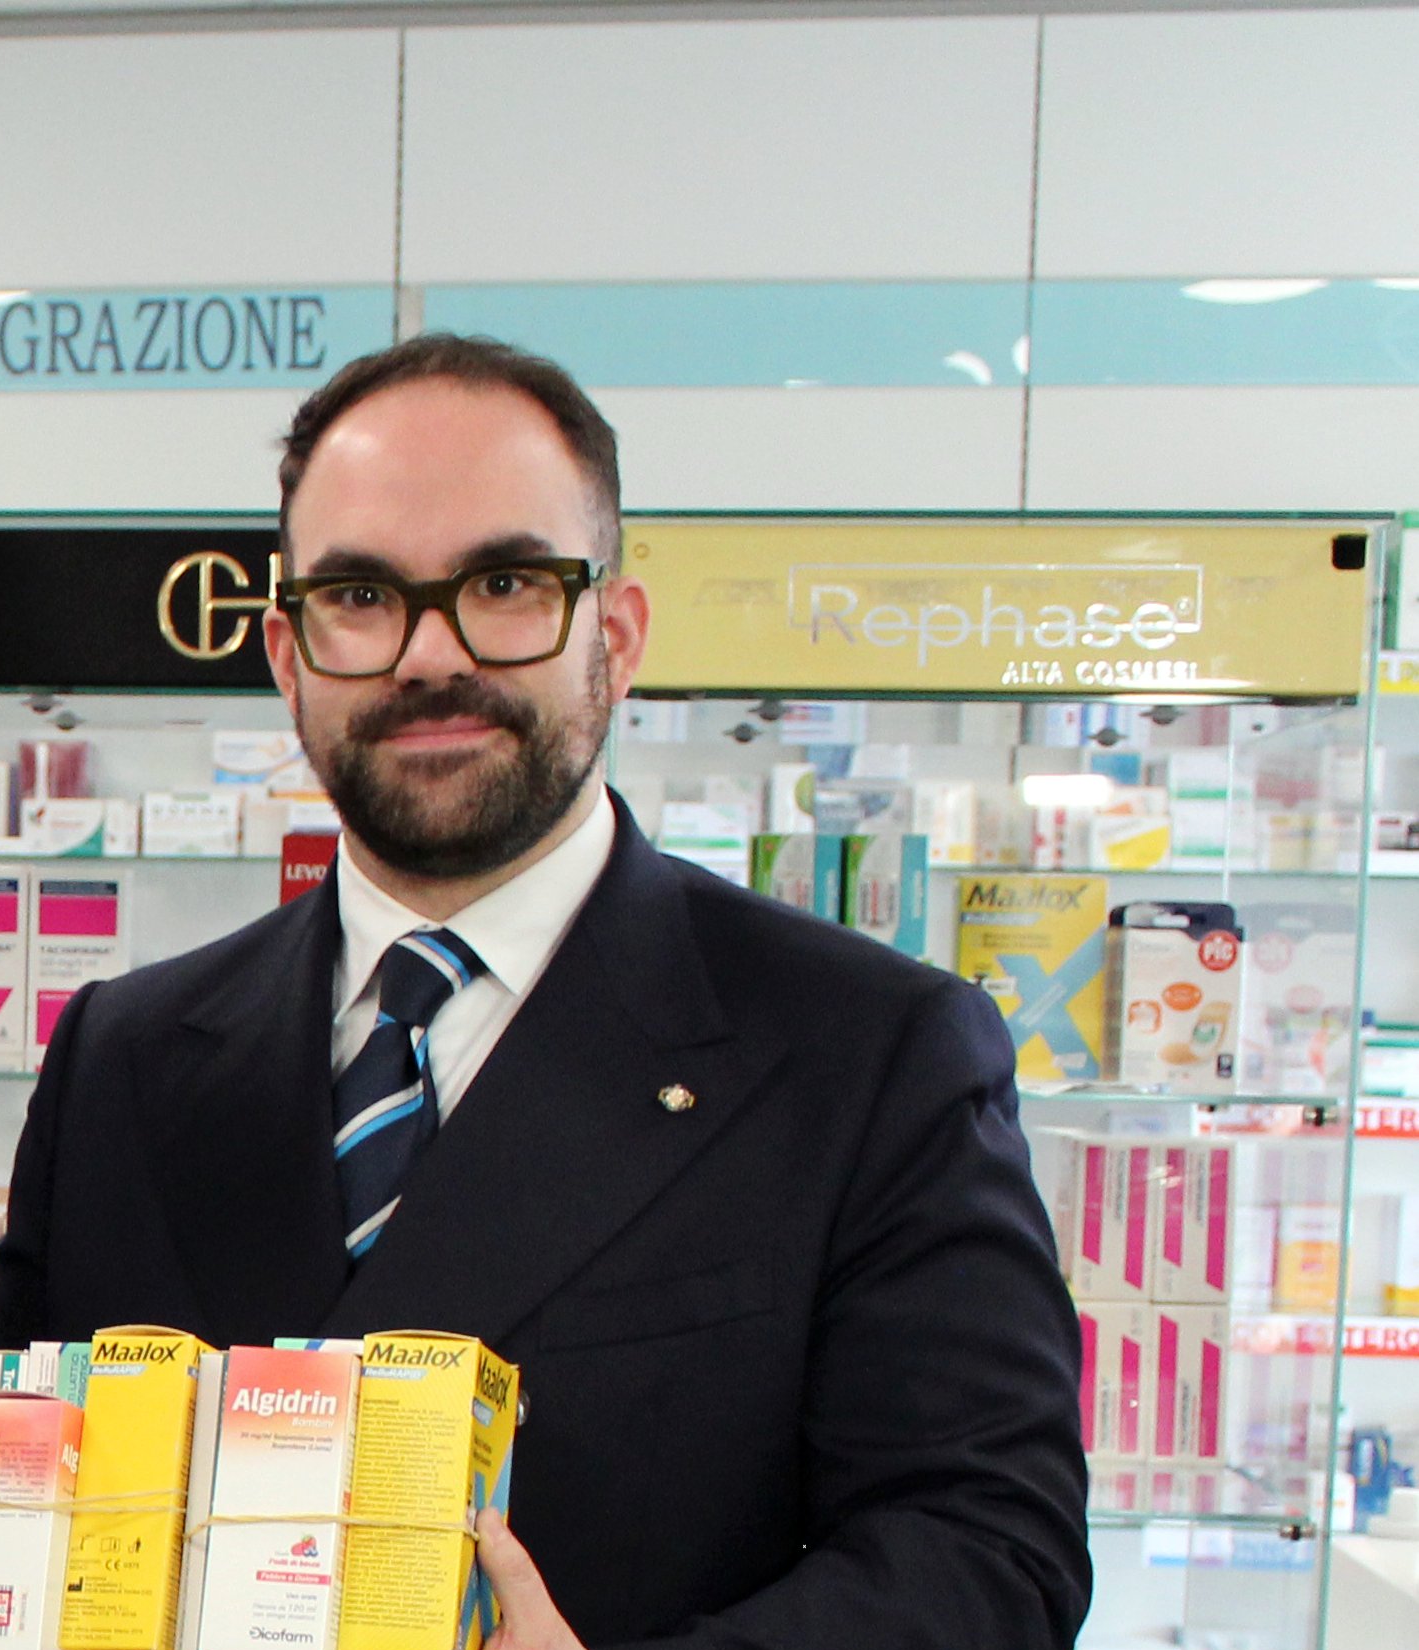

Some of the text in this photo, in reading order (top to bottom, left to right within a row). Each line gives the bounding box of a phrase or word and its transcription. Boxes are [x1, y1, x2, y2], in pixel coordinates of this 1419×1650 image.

[809, 584, 1178, 668] Rephase
[1001, 660, 1064, 686] ALTA
[965, 880, 1086, 912] Maalox
[93, 1341, 184, 1365] Maalox
[366, 1341, 469, 1370] Maalox
[231, 1386, 338, 1417] Algidrin
[249, 1625, 314, 1644] Dicofarm
